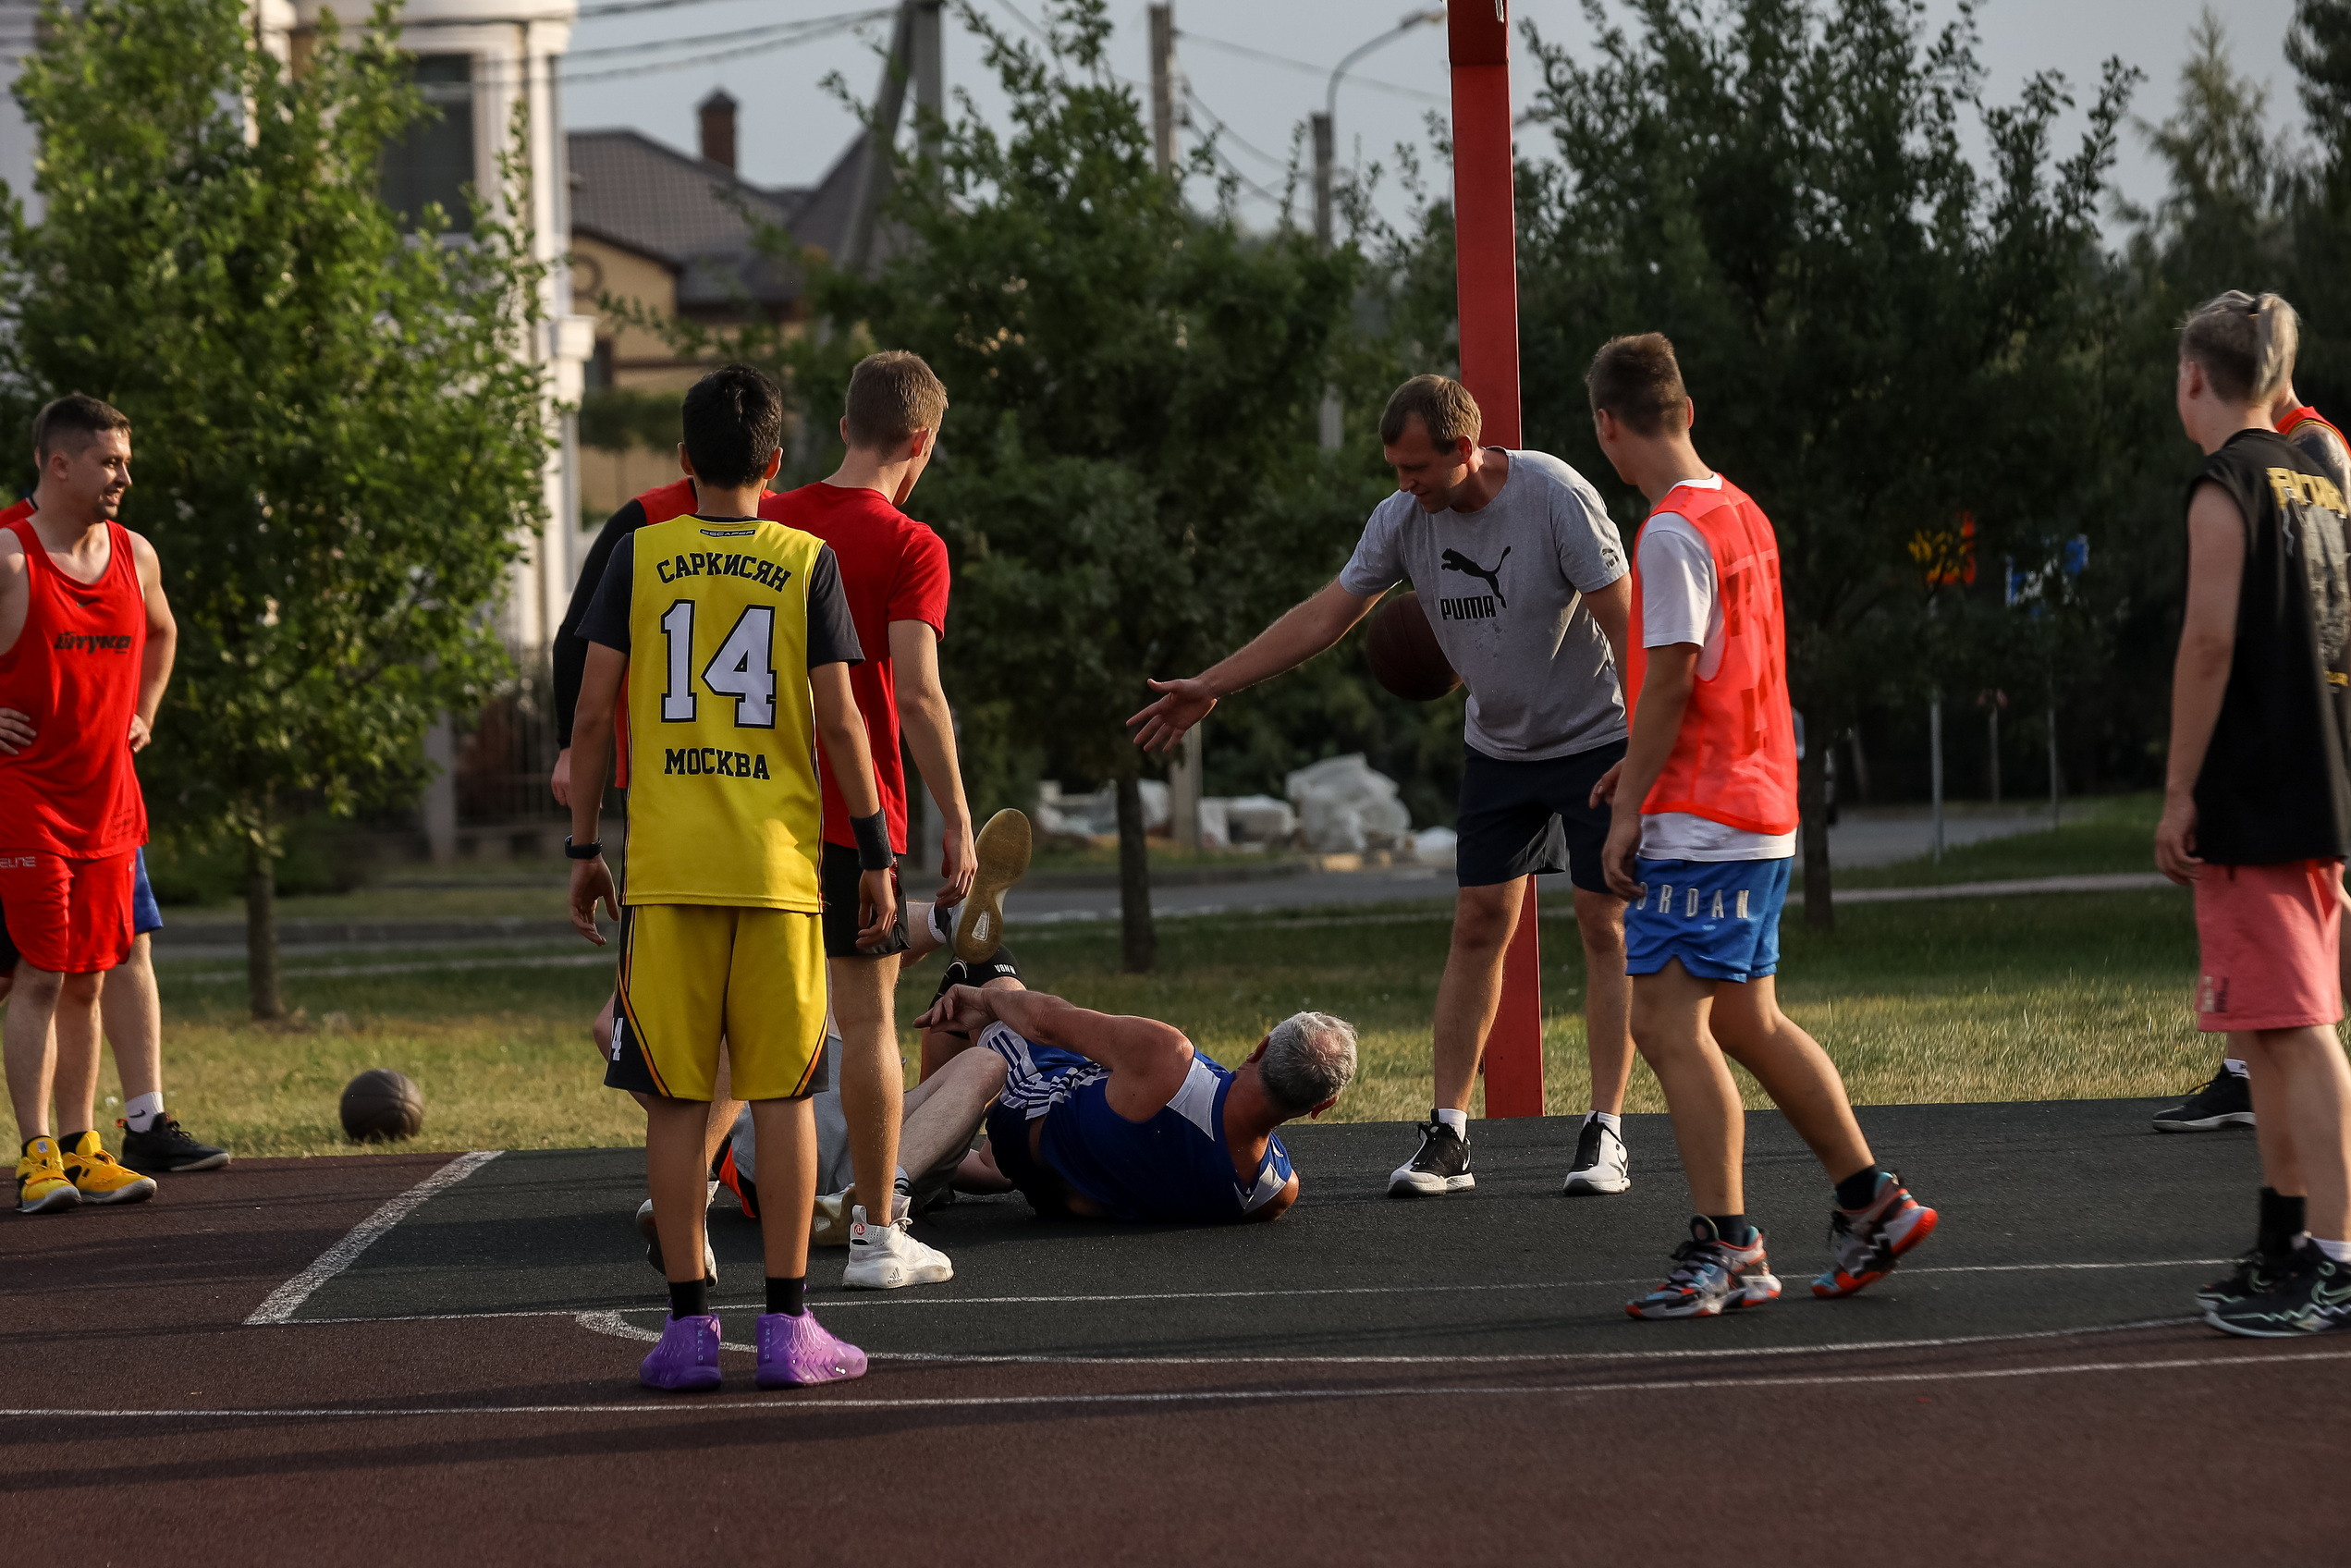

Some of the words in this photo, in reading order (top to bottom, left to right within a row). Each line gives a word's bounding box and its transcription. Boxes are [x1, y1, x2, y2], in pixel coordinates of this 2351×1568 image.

[656, 552, 792, 593] САРКИСЯН
[1439, 595, 1497, 620] PUMA
[660, 599, 778, 729] 14
[664, 748, 770, 780] МОСКВА
[611, 1017, 624, 1061] 4
